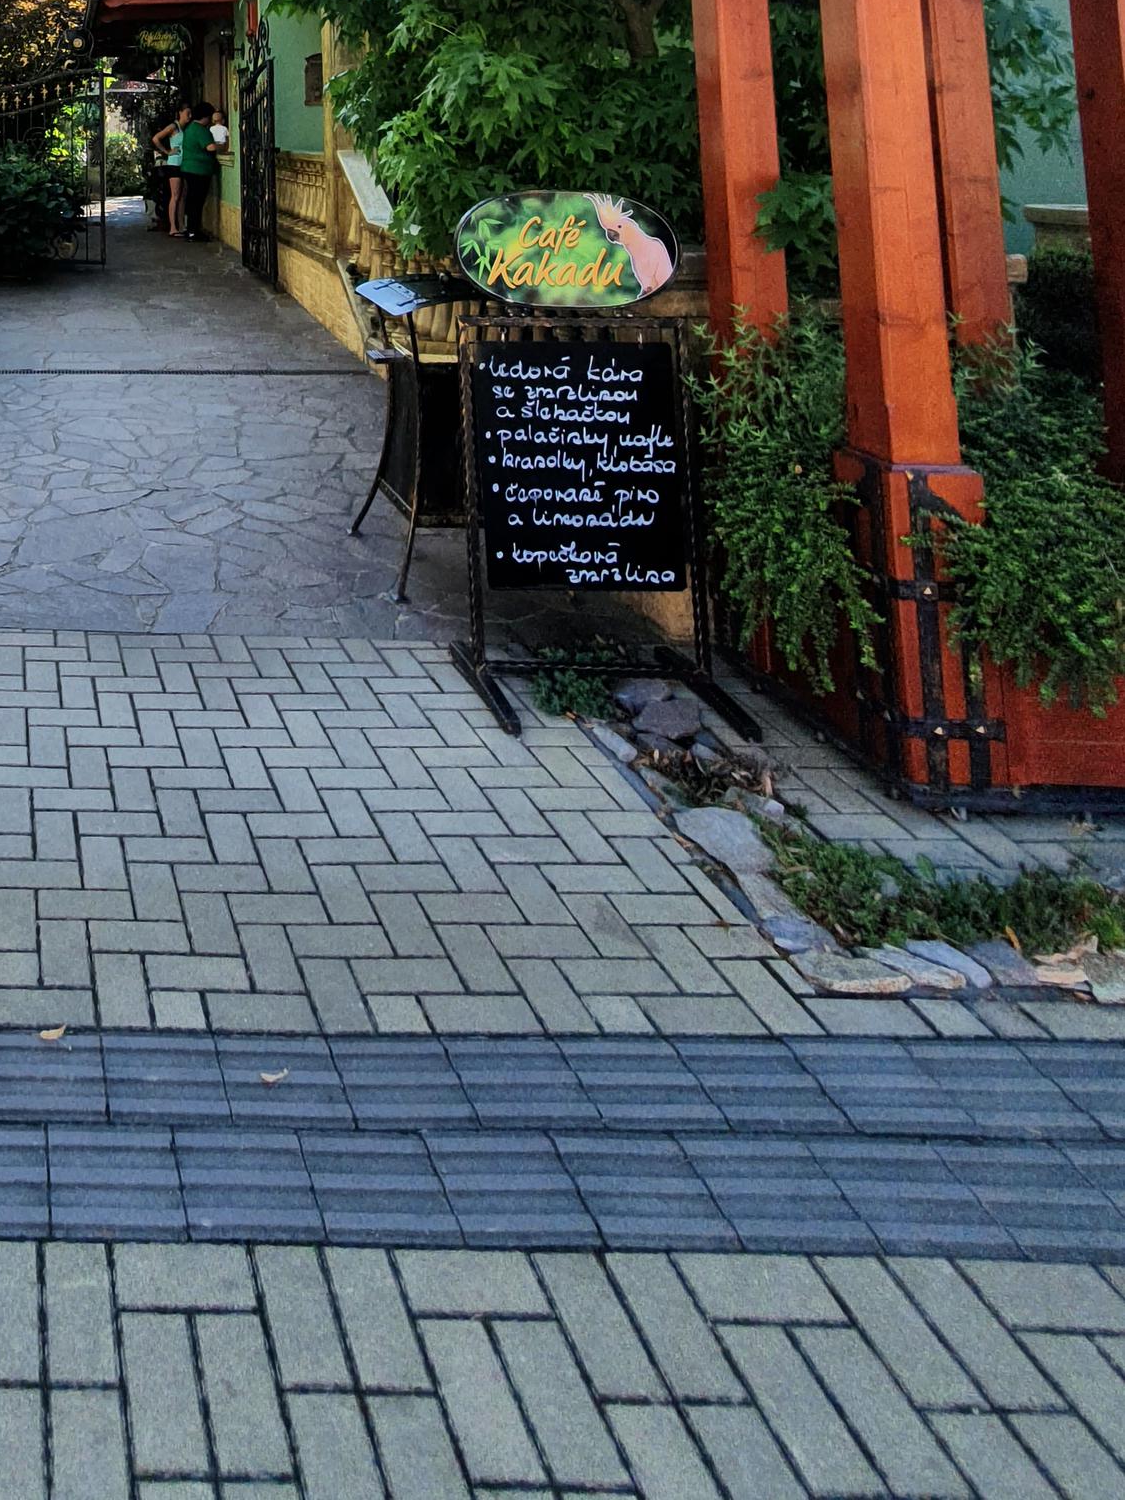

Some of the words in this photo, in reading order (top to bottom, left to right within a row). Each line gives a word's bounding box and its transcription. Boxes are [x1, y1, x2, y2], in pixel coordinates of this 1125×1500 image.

[518, 214, 587, 255] Café
[486, 248, 624, 289] Kakadu
[492, 385, 515, 399] se
[496, 406, 515, 418] a
[508, 513, 524, 526] a
